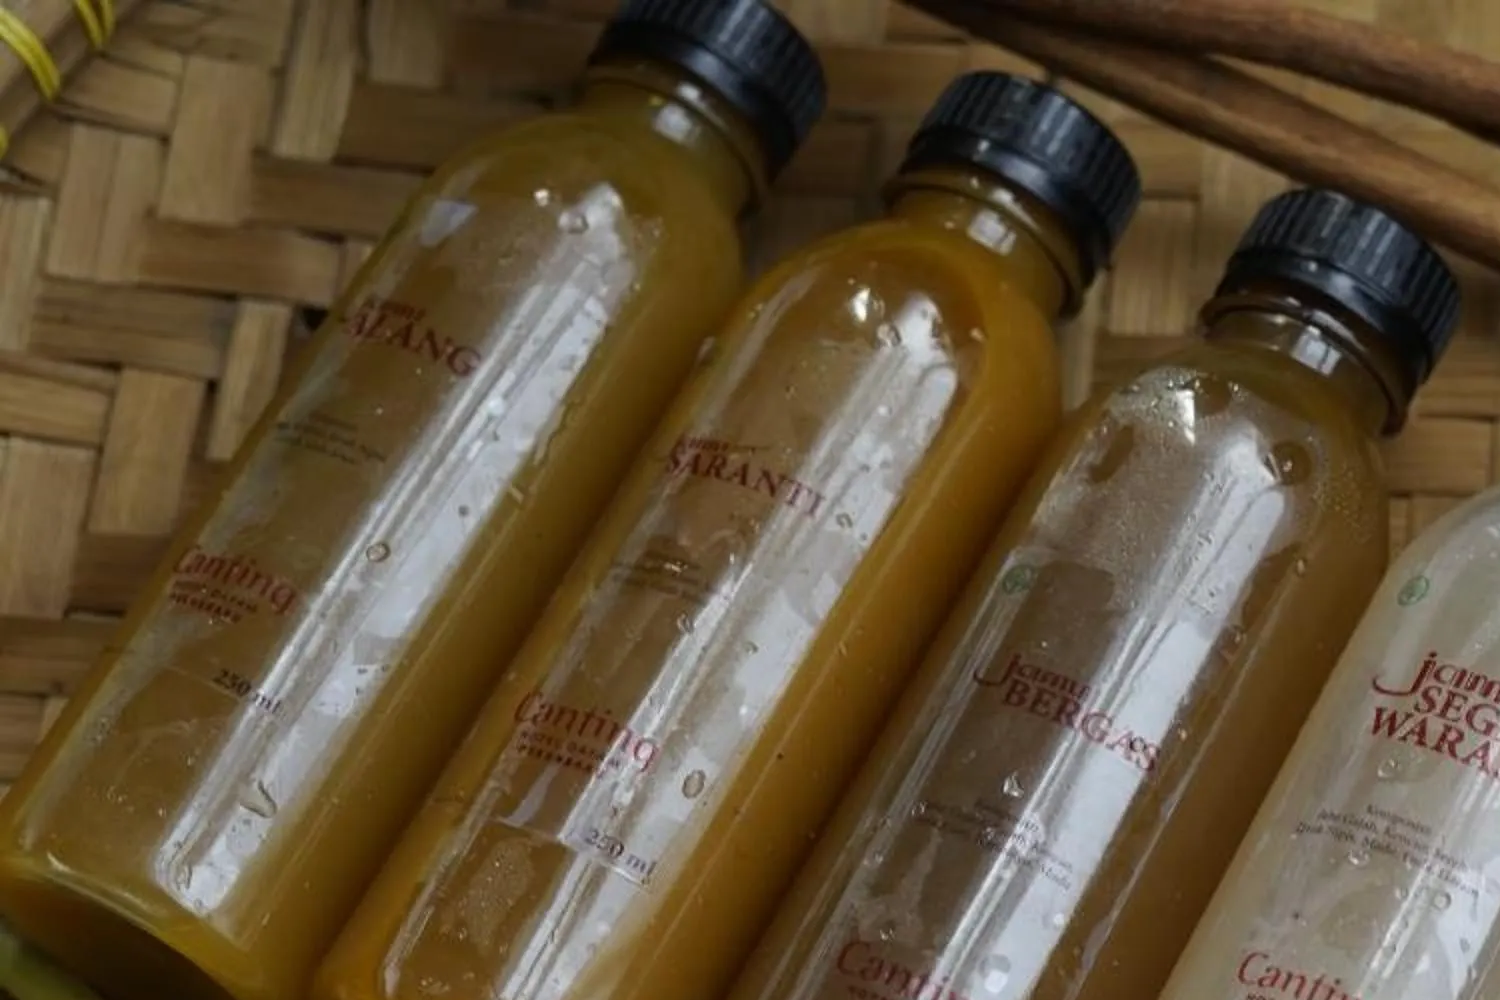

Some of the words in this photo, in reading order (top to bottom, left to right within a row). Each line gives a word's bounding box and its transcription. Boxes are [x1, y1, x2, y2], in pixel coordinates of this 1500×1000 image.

[668, 452, 825, 519] SARANTI
[173, 547, 299, 616] Canting
[513, 690, 661, 773] Canting
[1002, 679, 1161, 772] BERGAS
